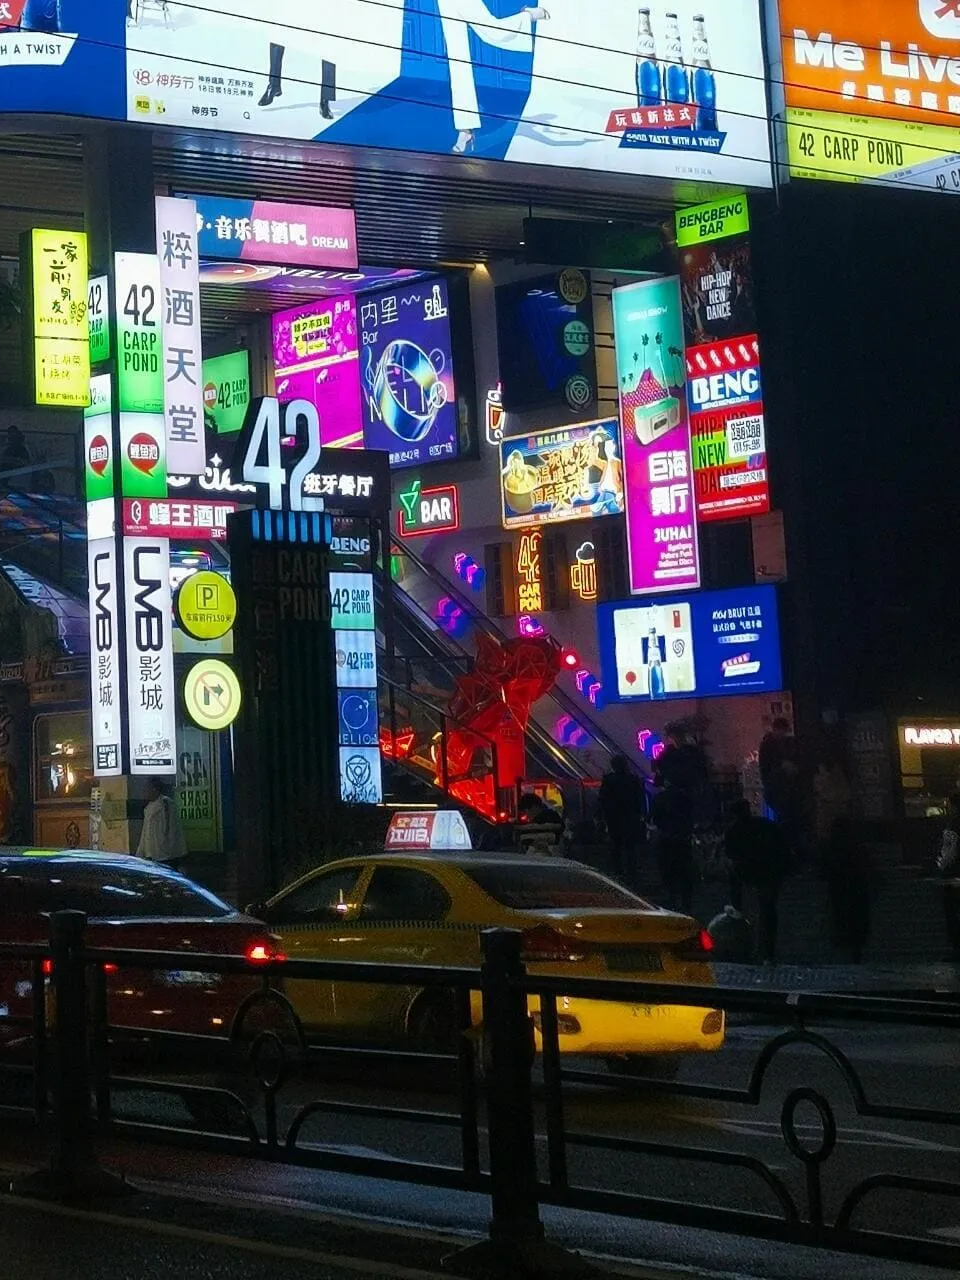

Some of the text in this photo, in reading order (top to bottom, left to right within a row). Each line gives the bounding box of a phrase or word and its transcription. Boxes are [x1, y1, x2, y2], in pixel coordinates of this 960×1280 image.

[14, 44, 21, 54] A
[27, 44, 62, 55] TWIST
[793, 29, 865, 71] Me
[614, 107, 691, 127] 玩味新法式
[649, 134, 670, 144] TASTE
[671, 136, 690, 146] WITH
[691, 137, 697, 146] A
[698, 136, 720, 147] TWIST
[799, 132, 904, 166] 42 CARP POND
[679, 203, 743, 229] BENGBENG
[196, 213, 308, 247] ·音乐餐酒吧
[700, 221, 724, 237] BAR
[312, 236, 349, 250] DREAM
[701, 271, 732, 291] HIP-HOP
[88, 284, 102, 316] 42
[124, 284, 156, 327] 42
[709, 287, 727, 305] NEW
[706, 301, 732, 321] DANCE
[123, 330, 157, 351] CARP
[163, 229, 199, 444] 粹酒天堂
[362, 331, 379, 346] Bar
[124, 352, 158, 372] POND
[218, 381, 231, 409] 42
[232, 378, 246, 392] CARP
[692, 368, 759, 404] BENG
[243, 397, 324, 512] 42
[698, 441, 725, 469] NEW
[421, 498, 451, 521] BAR
[330, 536, 371, 552] BENG
[654, 525, 692, 543] JUHAI
[332, 588, 370, 615] 42 CARP
[352, 601, 371, 614] POND
[346, 651, 359, 670] 42
[98, 655, 113, 707] 影城
[140, 656, 163, 710] 影城
